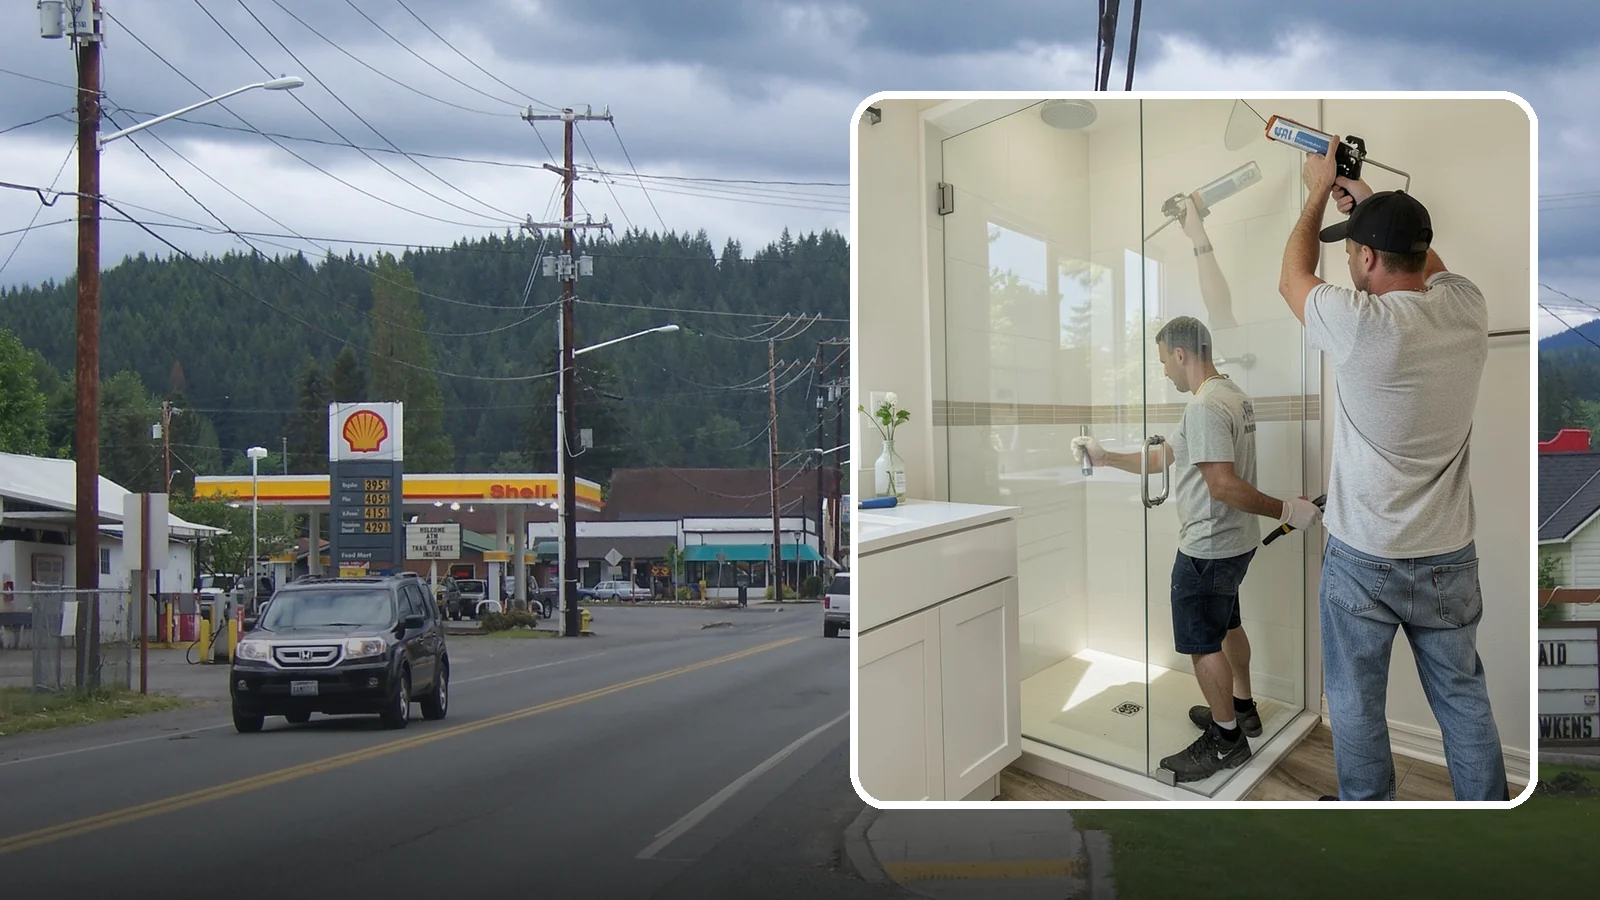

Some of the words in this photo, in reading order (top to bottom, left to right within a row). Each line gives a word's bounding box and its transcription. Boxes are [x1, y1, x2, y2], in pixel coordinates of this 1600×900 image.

[366, 480, 384, 490] 395
[490, 484, 547, 499] Shell
[366, 494, 384, 504] 405
[366, 508, 384, 518] 415
[366, 522, 384, 532] 429
